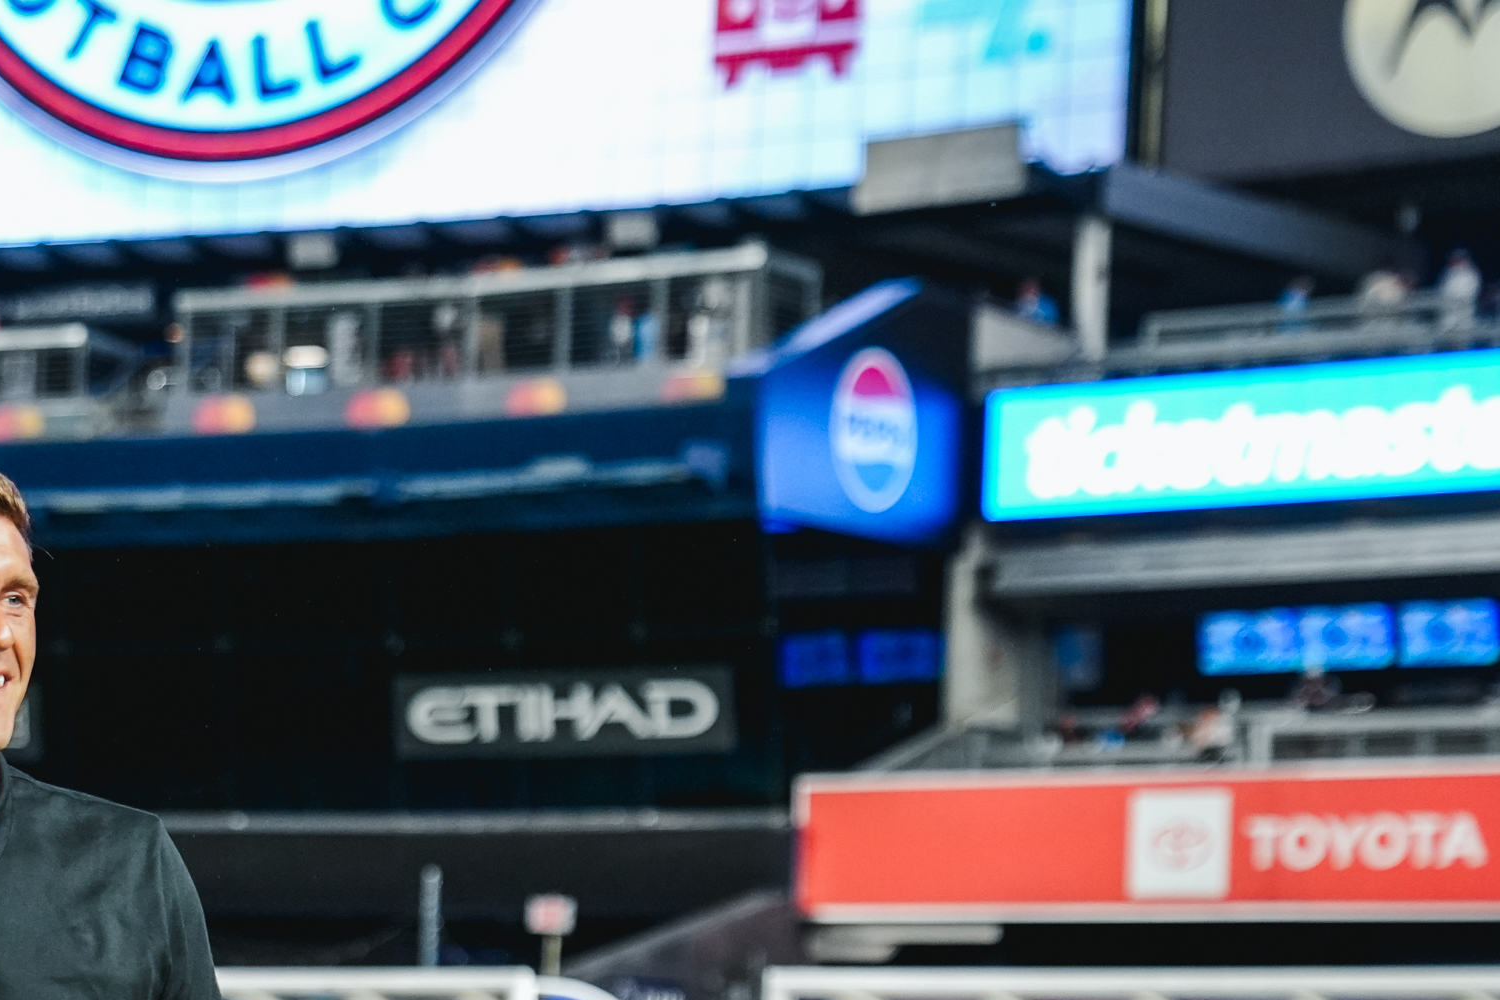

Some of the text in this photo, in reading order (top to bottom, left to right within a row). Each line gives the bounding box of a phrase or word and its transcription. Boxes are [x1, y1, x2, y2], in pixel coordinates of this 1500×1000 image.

[8, 0, 362, 104] TBALL
[405, 679, 720, 744] ETIHAD
[1242, 810, 1489, 872] TOYOTA
